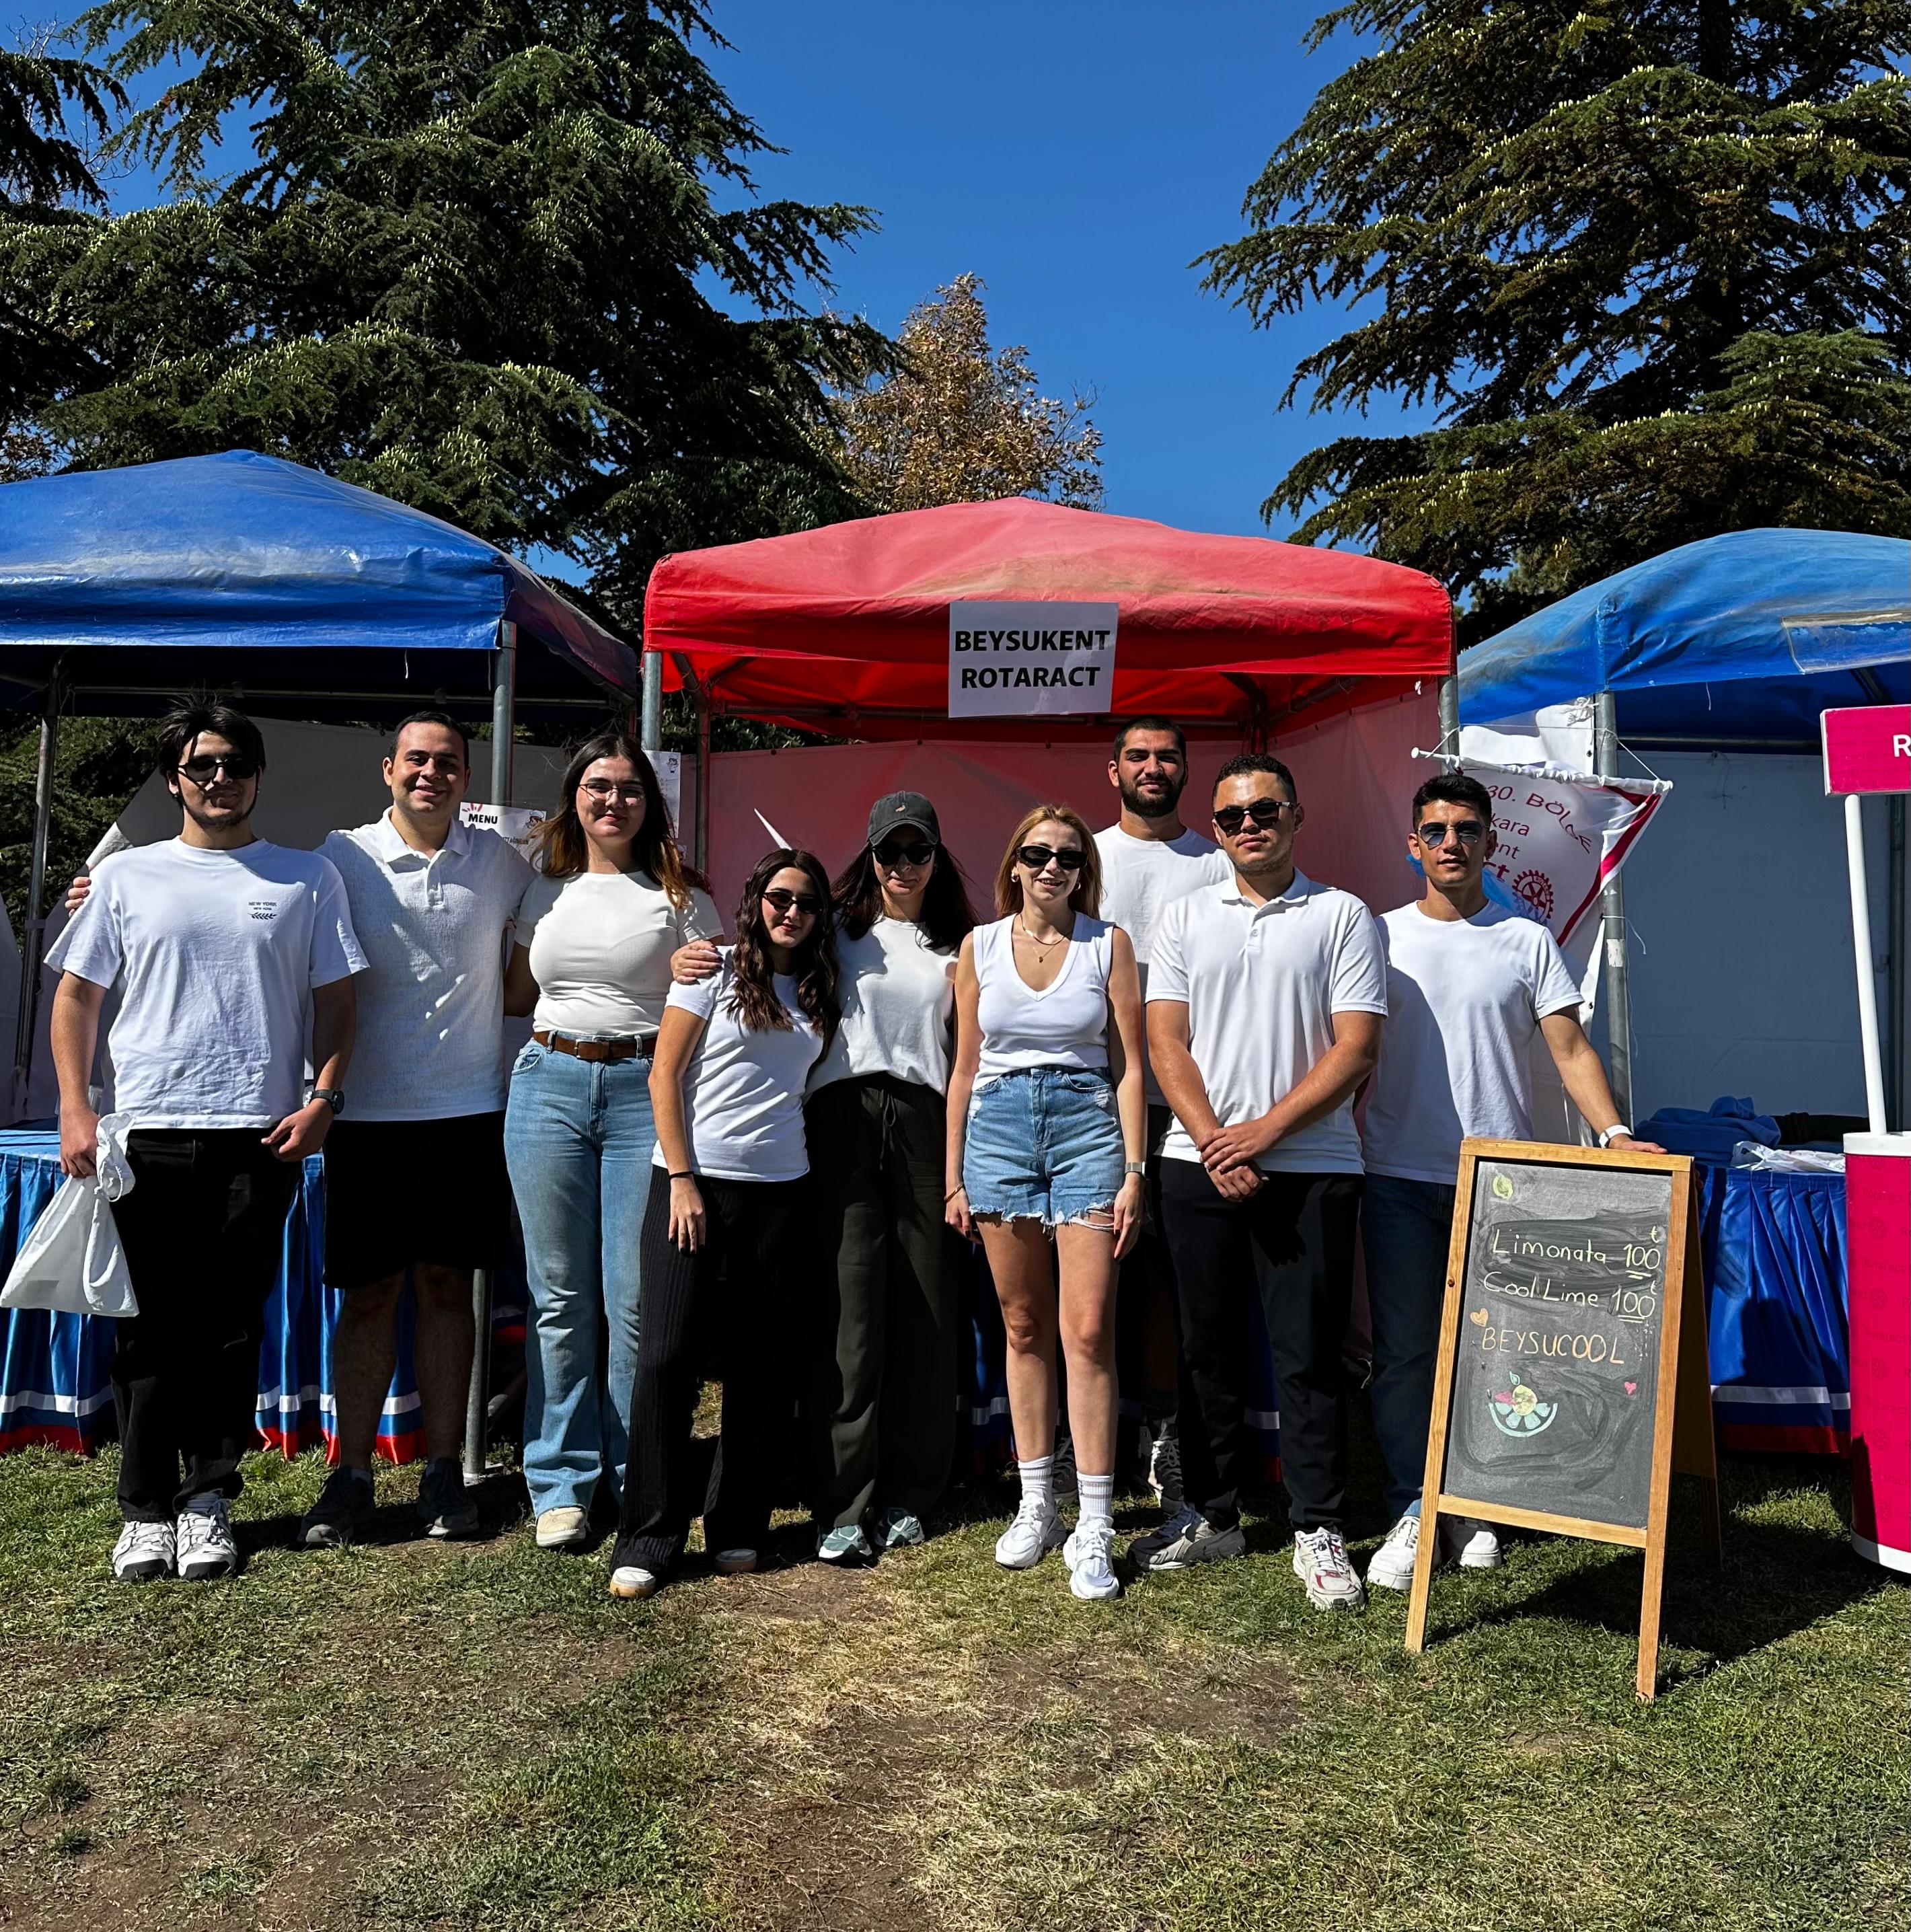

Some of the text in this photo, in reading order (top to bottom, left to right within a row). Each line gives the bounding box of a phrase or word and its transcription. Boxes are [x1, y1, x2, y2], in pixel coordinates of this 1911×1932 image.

[954, 630, 1111, 652] BEYSUKENT
[961, 666, 1101, 689] ROTARACT
[467, 813, 498, 825] MENU
[1493, 1228, 1607, 1264] Limonata
[1623, 1243, 1660, 1269] 100
[1484, 1271, 1537, 1298] Cool
[1542, 1279, 1599, 1308] Lime
[1612, 1288, 1655, 1317] 100
[1482, 1326, 1625, 1365] BEYSUCOOL
